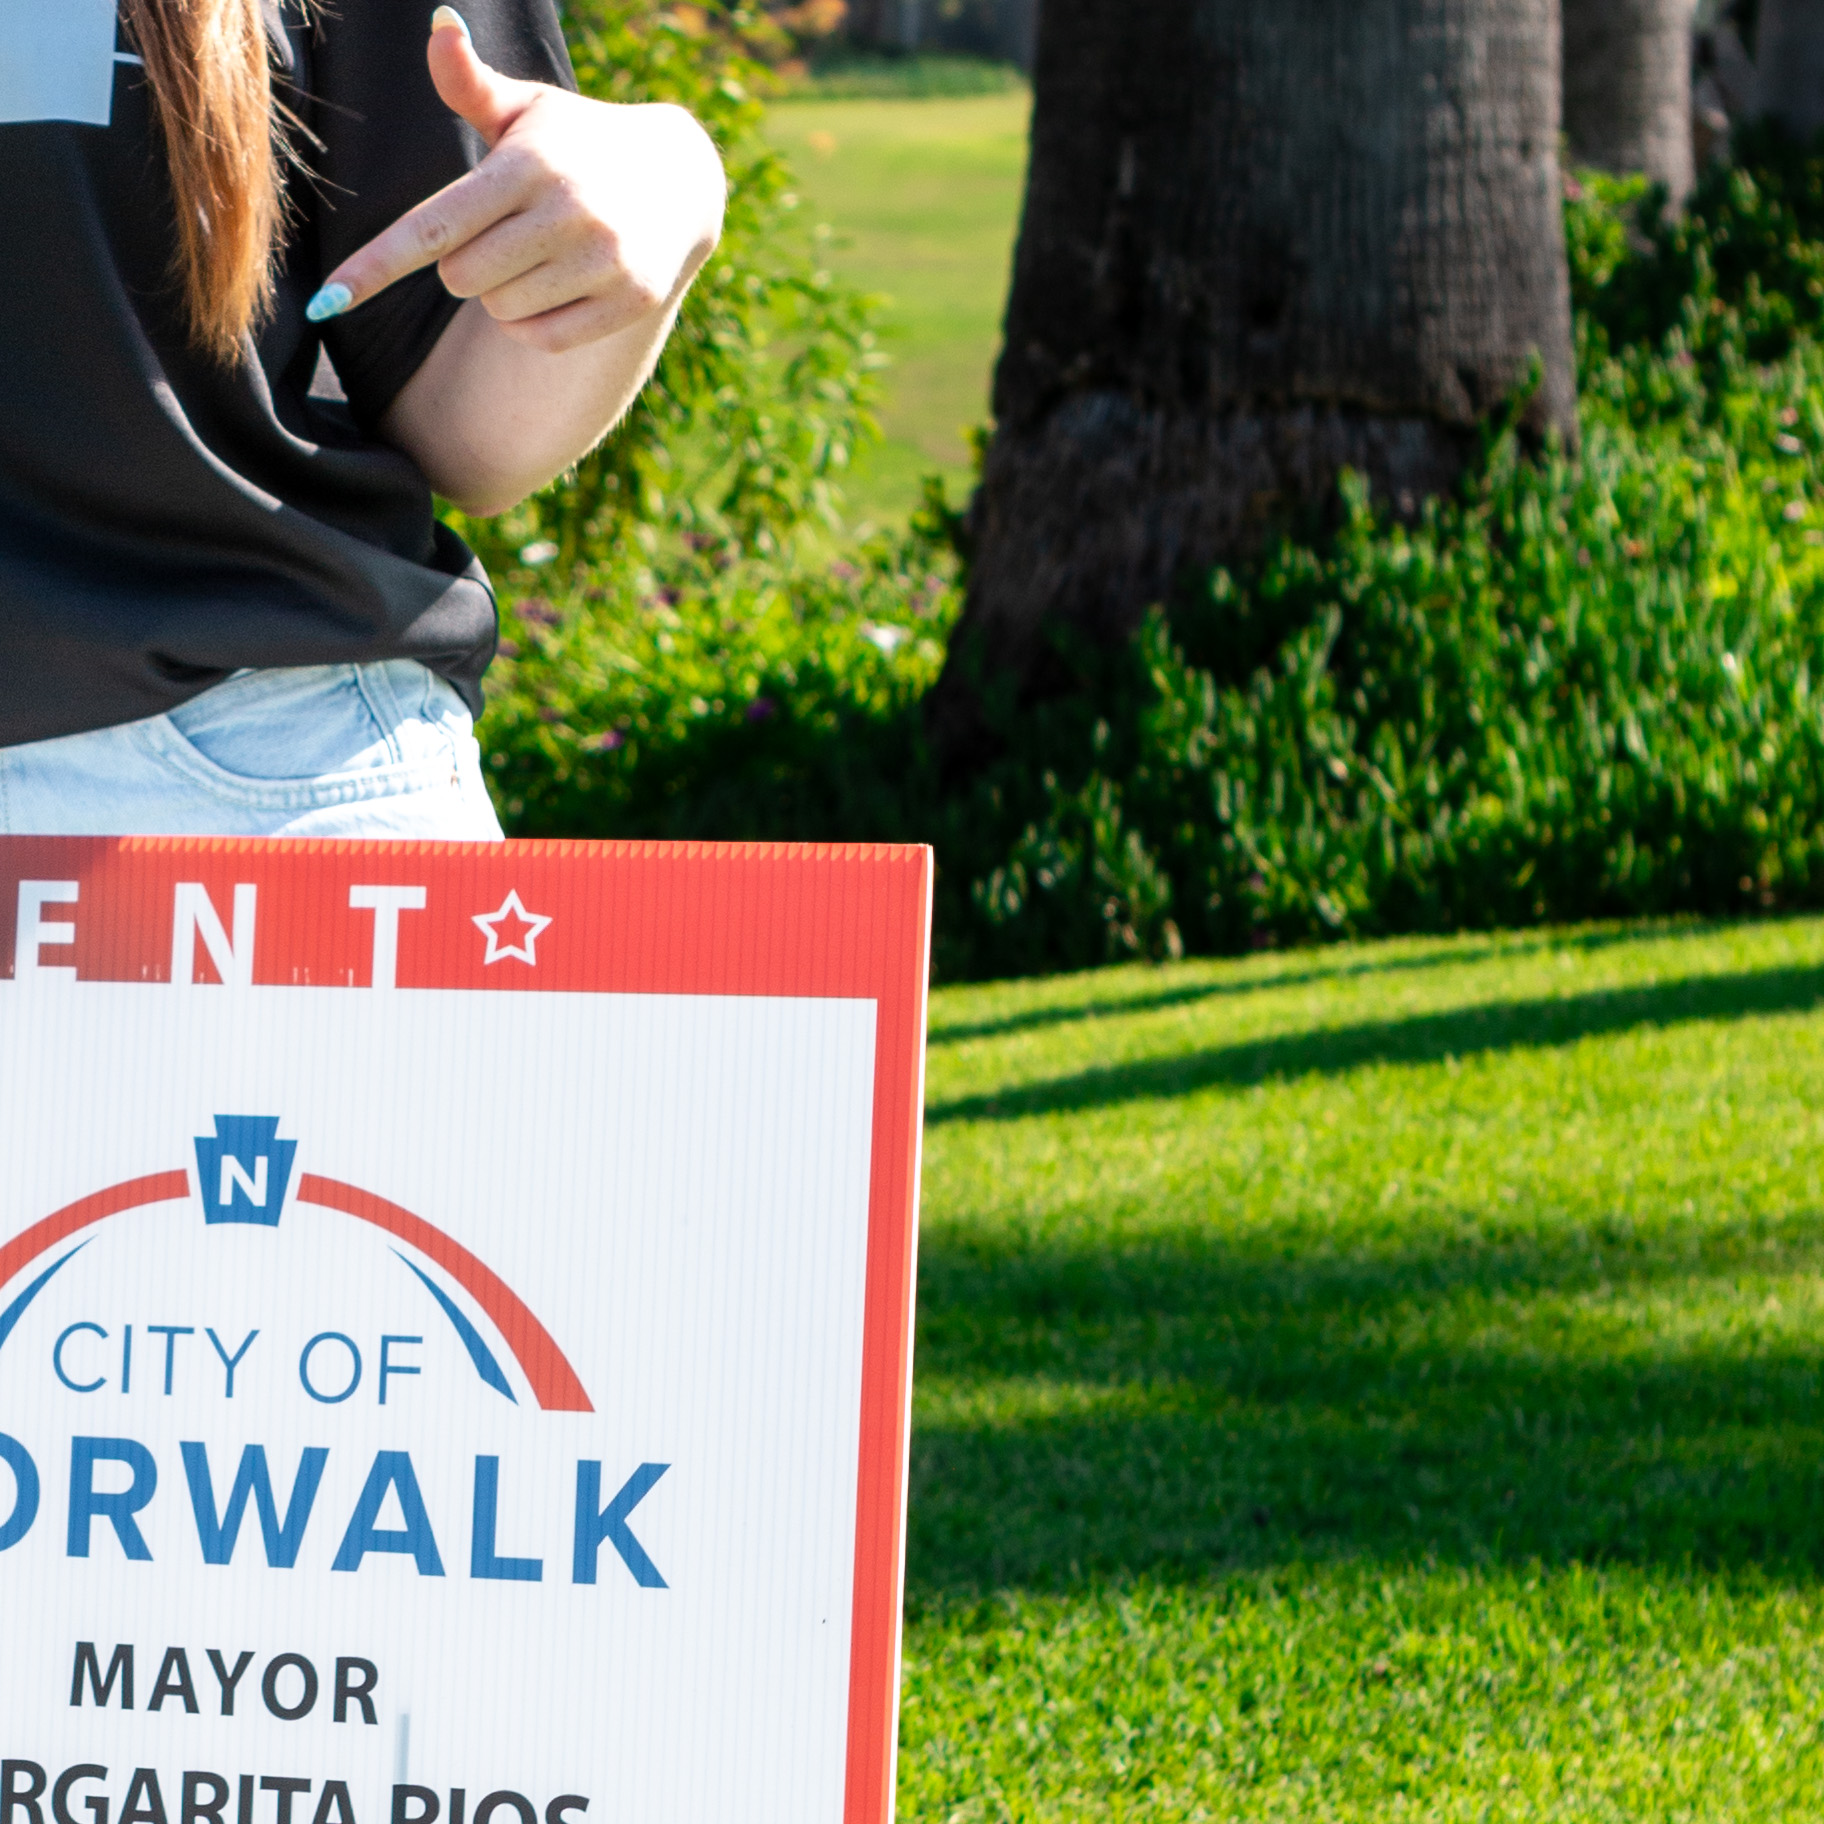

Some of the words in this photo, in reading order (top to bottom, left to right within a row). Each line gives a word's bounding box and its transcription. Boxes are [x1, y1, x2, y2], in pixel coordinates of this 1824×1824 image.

[219, 1154, 268, 1207] N
[51, 1320, 261, 1398] CITY
[298, 1330, 424, 1406] OF
[68, 1640, 381, 1725] MAYOR
